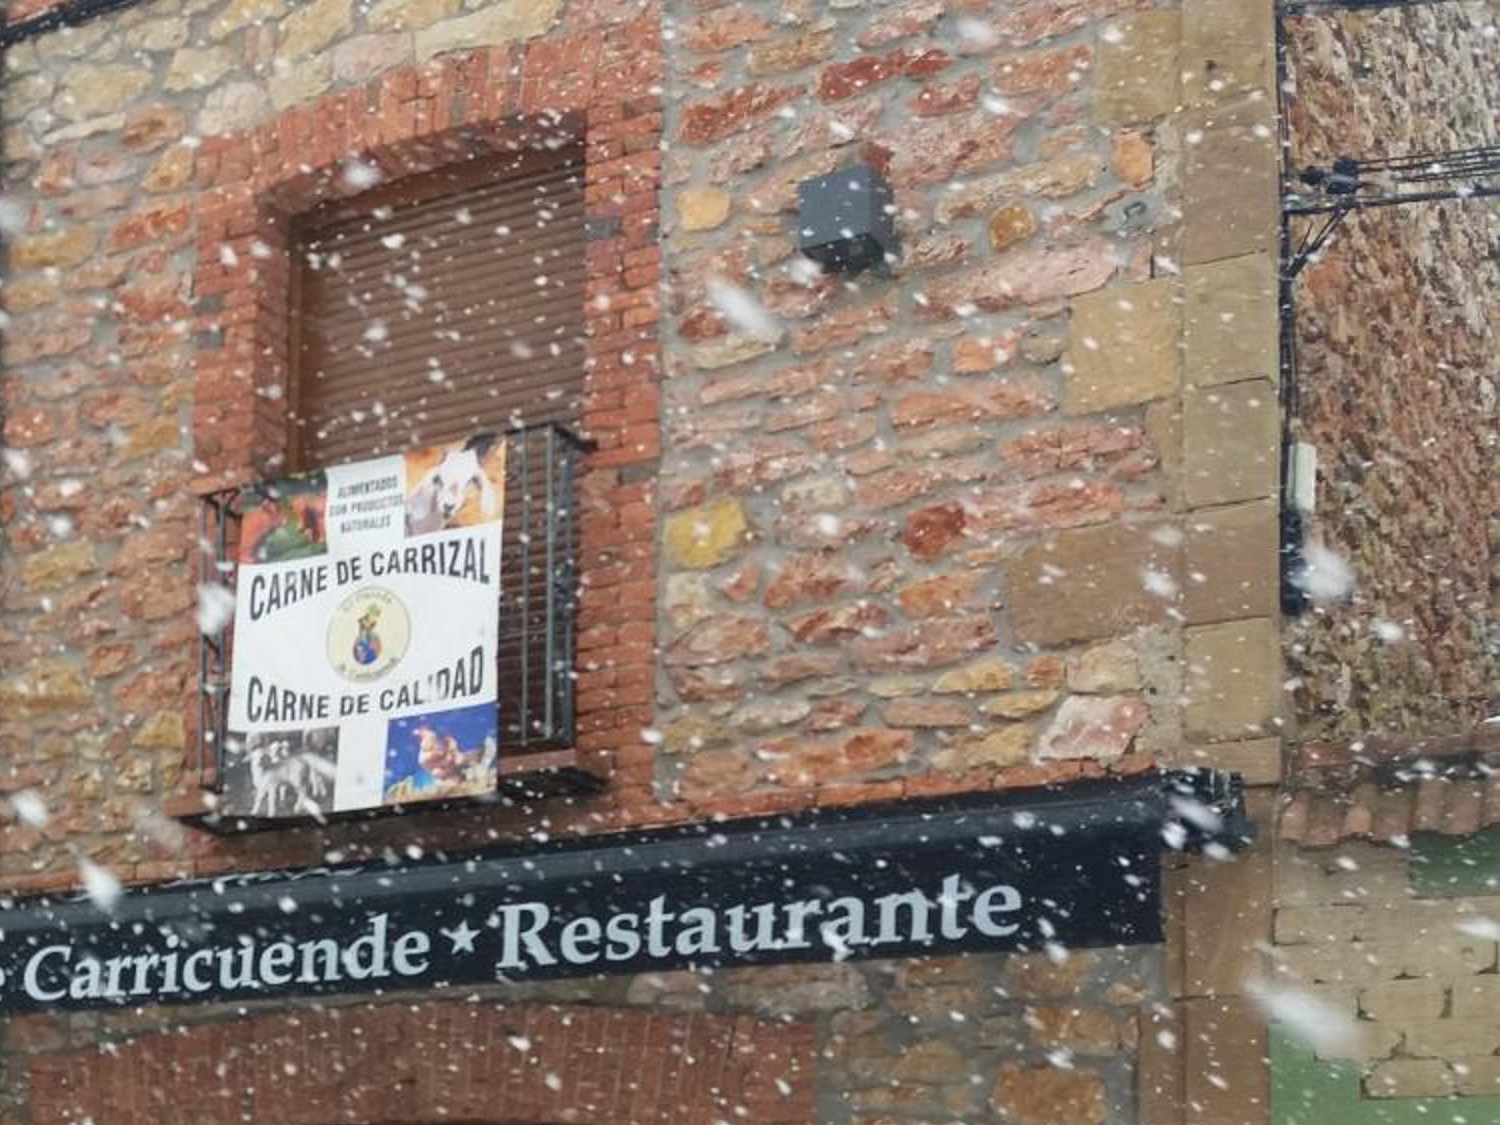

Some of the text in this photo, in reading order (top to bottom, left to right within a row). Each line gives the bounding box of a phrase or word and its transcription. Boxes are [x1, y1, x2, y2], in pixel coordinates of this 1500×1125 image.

[338, 475, 398, 499] ALIMENTADOS
[340, 514, 391, 533] NATURALES
[250, 538, 490, 621] CARNE DE CARRIZAL
[246, 676, 329, 723] CARNE
[339, 695, 370, 716] DE
[23, 913, 431, 1001] Carricuende
[494, 872, 1024, 969] Restaurante
